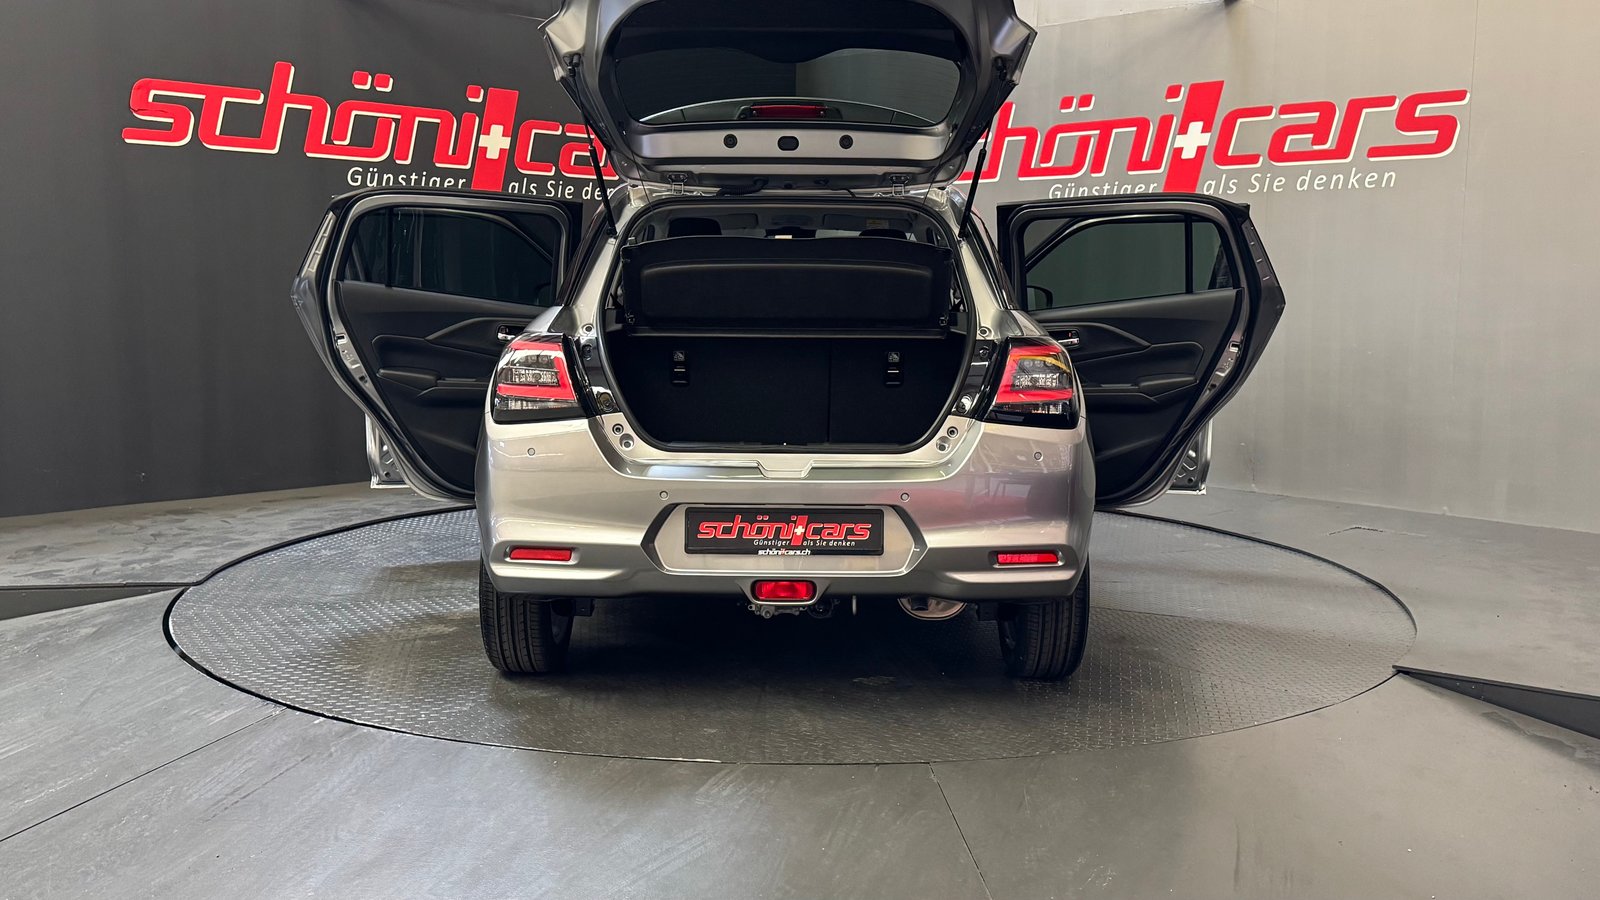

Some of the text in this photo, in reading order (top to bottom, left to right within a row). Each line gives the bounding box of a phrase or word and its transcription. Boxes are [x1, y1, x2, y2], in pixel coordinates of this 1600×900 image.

[514, 119, 620, 180] ca
[347, 166, 467, 189] Günstiger
[546, 180, 574, 199] Sie
[1203, 174, 1238, 195] als
[1247, 173, 1286, 193] Sie
[1296, 167, 1396, 191] denken
[753, 539, 790, 547] Günstiger
